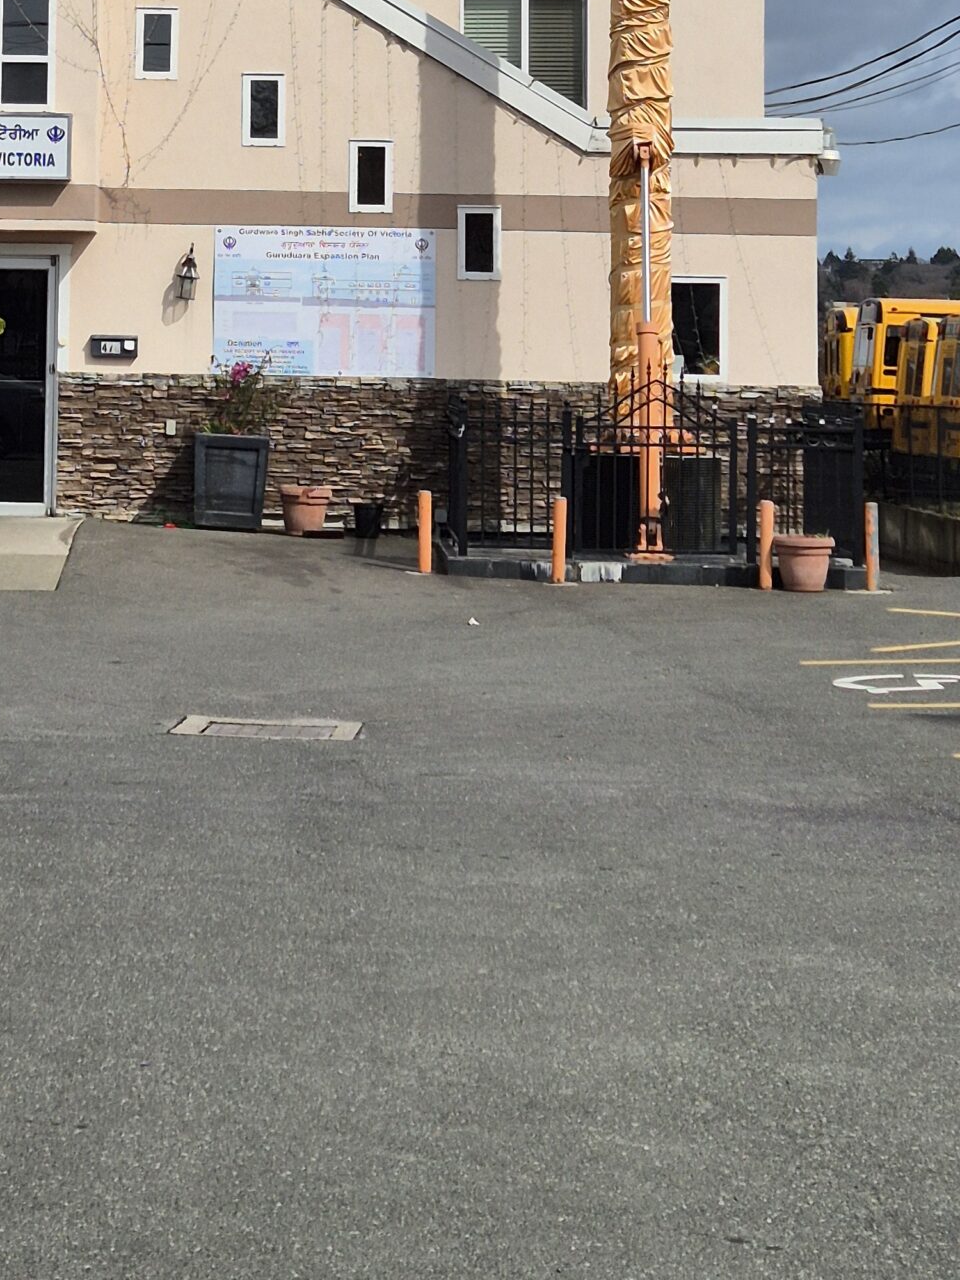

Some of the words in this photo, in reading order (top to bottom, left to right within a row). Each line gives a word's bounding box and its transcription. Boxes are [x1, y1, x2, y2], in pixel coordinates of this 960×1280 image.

[239, 228, 279, 236] Gurdwara
[281, 228, 304, 237] Singh
[334, 230, 365, 238] Society
[380, 230, 412, 238] Victoria
[266, 251, 311, 259] Guruduara
[314, 252, 358, 261] Expansion
[361, 253, 380, 261] Plan
[227, 339, 262, 348] Donation
